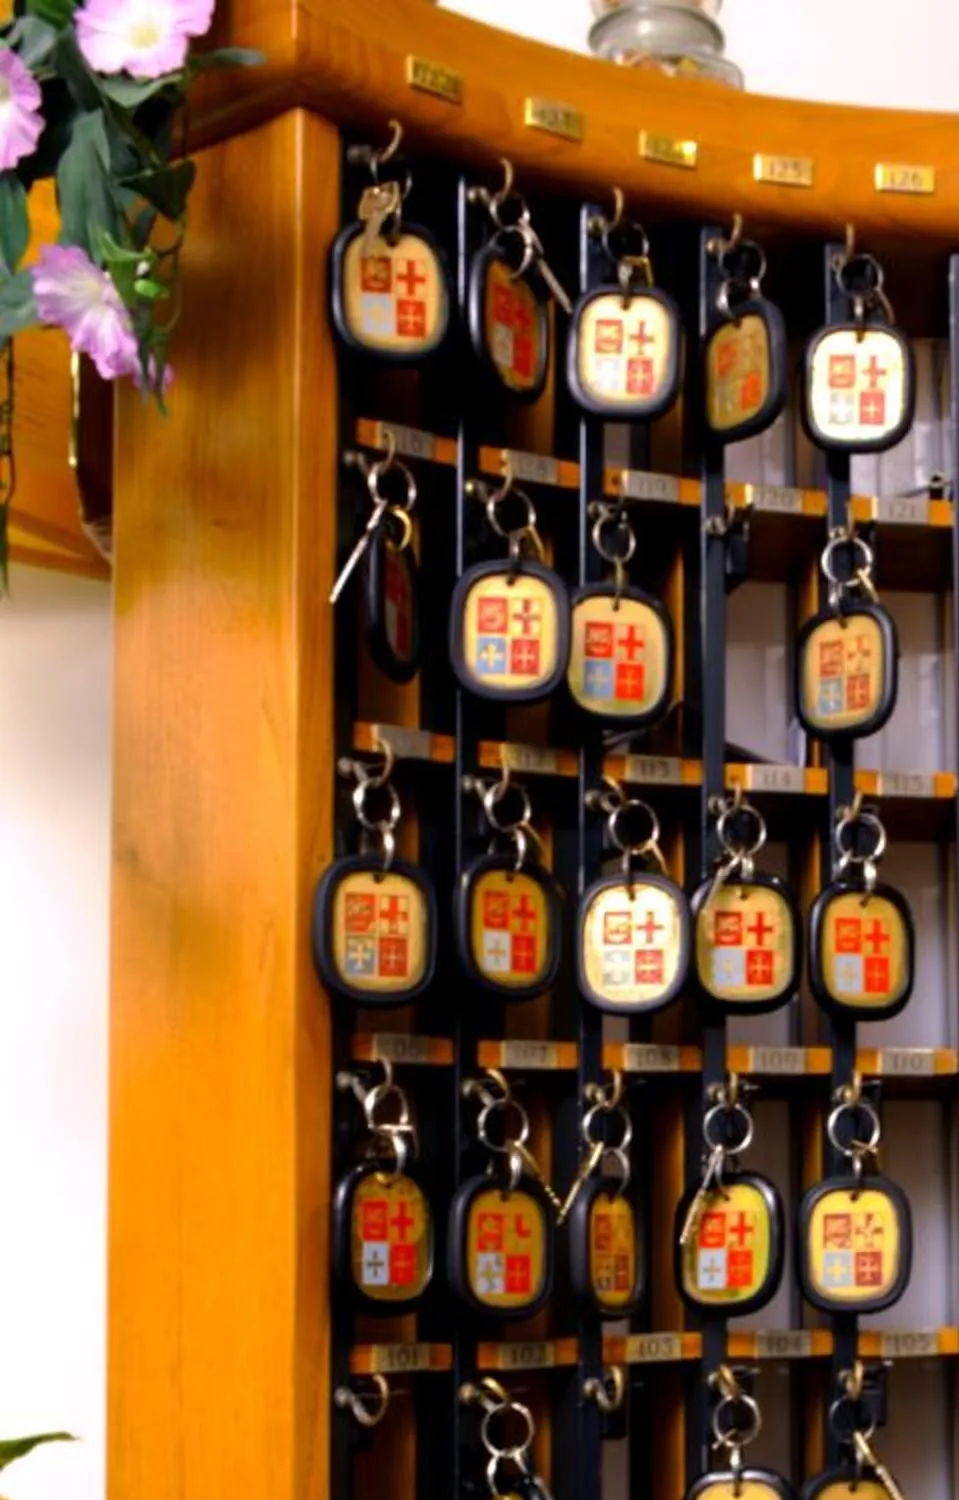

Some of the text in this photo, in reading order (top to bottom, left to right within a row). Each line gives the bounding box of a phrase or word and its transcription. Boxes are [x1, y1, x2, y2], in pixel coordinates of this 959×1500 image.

[769, 160, 803, 178] 125
[890, 172, 923, 187] 126
[888, 502, 917, 519] 121
[640, 760, 669, 778] 113
[763, 770, 791, 786] 114
[637, 1048, 672, 1066] 108
[761, 1051, 798, 1068] 109
[893, 1053, 923, 1071] 110
[639, 1336, 674, 1357] 103
[766, 1334, 802, 1352] 104
[894, 1333, 929, 1351] 105
[388, 1345, 418, 1366] 101
[511, 1342, 548, 1363] 102
